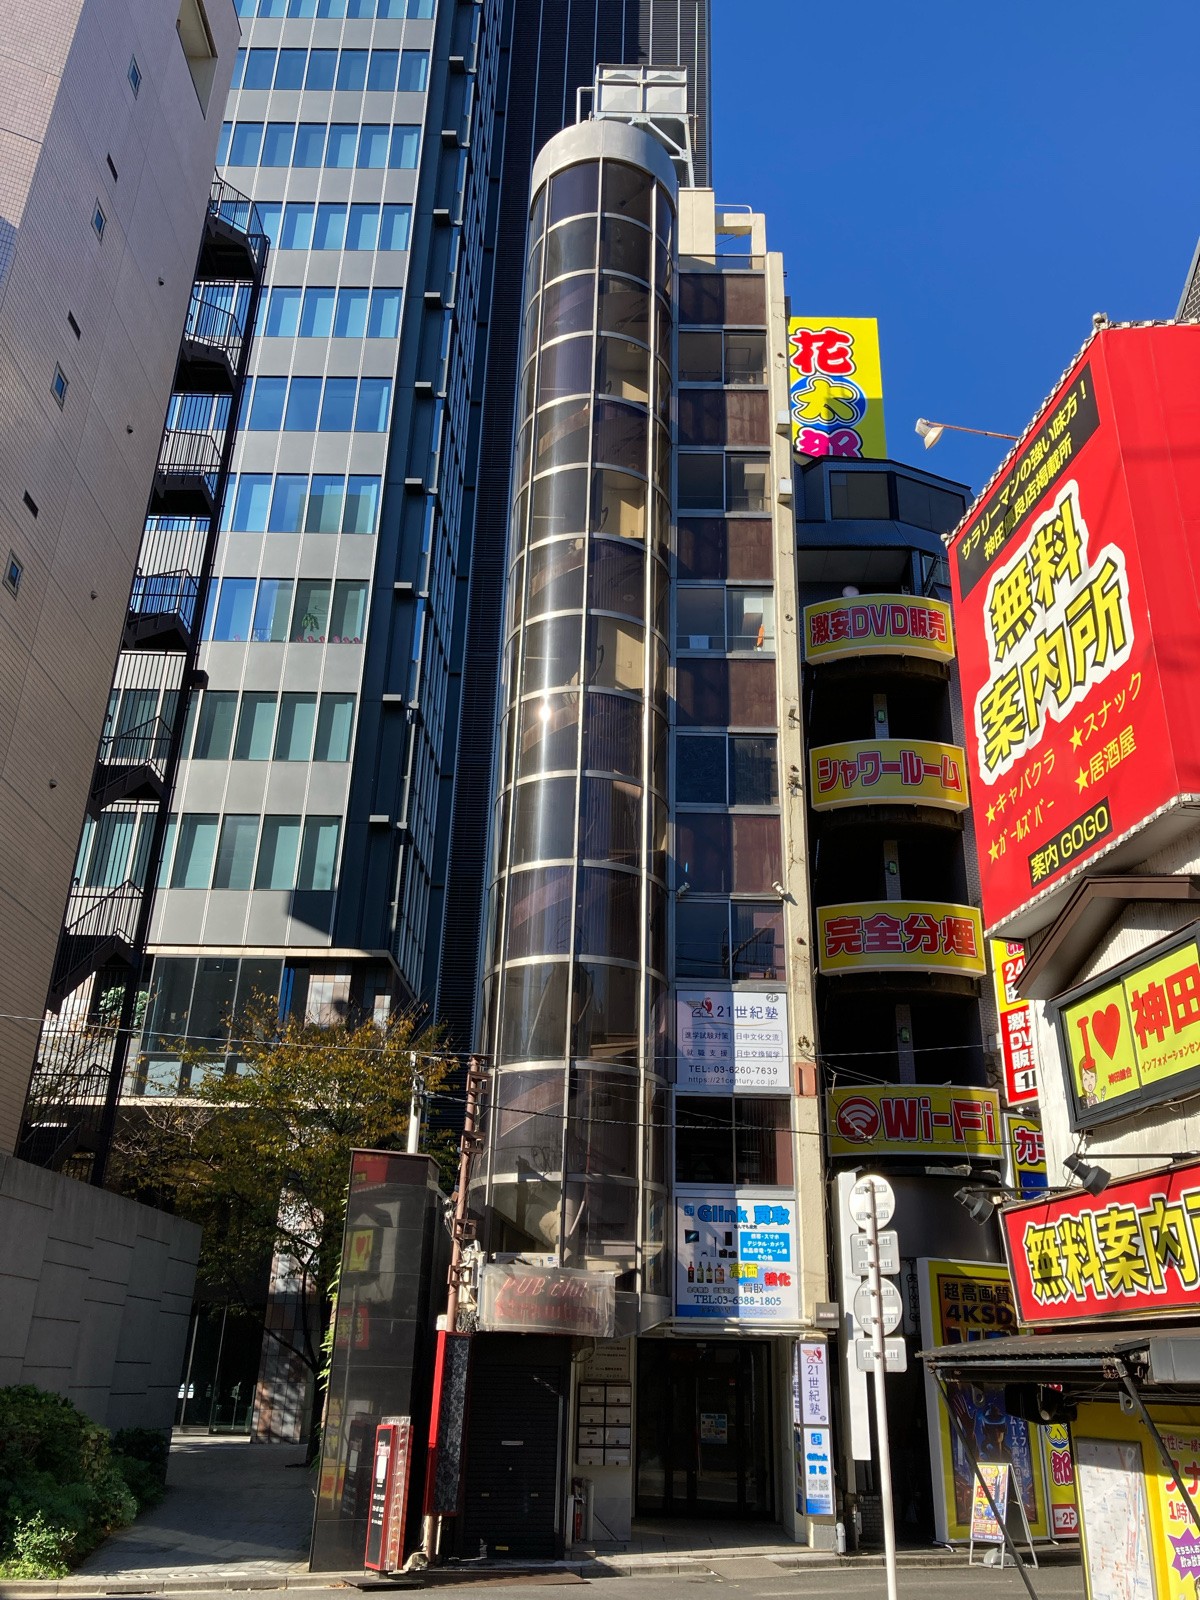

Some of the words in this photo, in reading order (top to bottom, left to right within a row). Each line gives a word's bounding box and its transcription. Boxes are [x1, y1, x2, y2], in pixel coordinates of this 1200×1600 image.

[984, 432, 1072, 561] 神田良店掲載所
[989, 492, 1083, 663] 無料
[811, 604, 947, 647] 激安DVD販売
[980, 556, 1129, 773] 案内所
[1084, 671, 1142, 741] スナック
[817, 750, 962, 793] シャワールーム
[1089, 725, 1137, 785] 居酒屋
[996, 748, 1055, 815] キャバクラ
[1031, 844, 1058, 883] 案内
[1061, 806, 1109, 858] GOGO
[824, 913, 978, 957] 完全分煙
[1005, 957, 1027, 982] 24
[717, 1006, 779, 1020] 21世紀塾
[1077, 1015, 1096, 1069] I
[1131, 964, 1200, 1050] 神田
[714, 1066, 778, 1075] 03-6260-7639
[880, 1097, 996, 1144] Wi-Fi
[697, 1204, 748, 1223] Glink
[754, 1205, 791, 1225] 買取
[1025, 1192, 1200, 1299] 無料案内
[944, 1282, 1010, 1303] 超高画質
[1062, 1511, 1074, 1525] 2F
